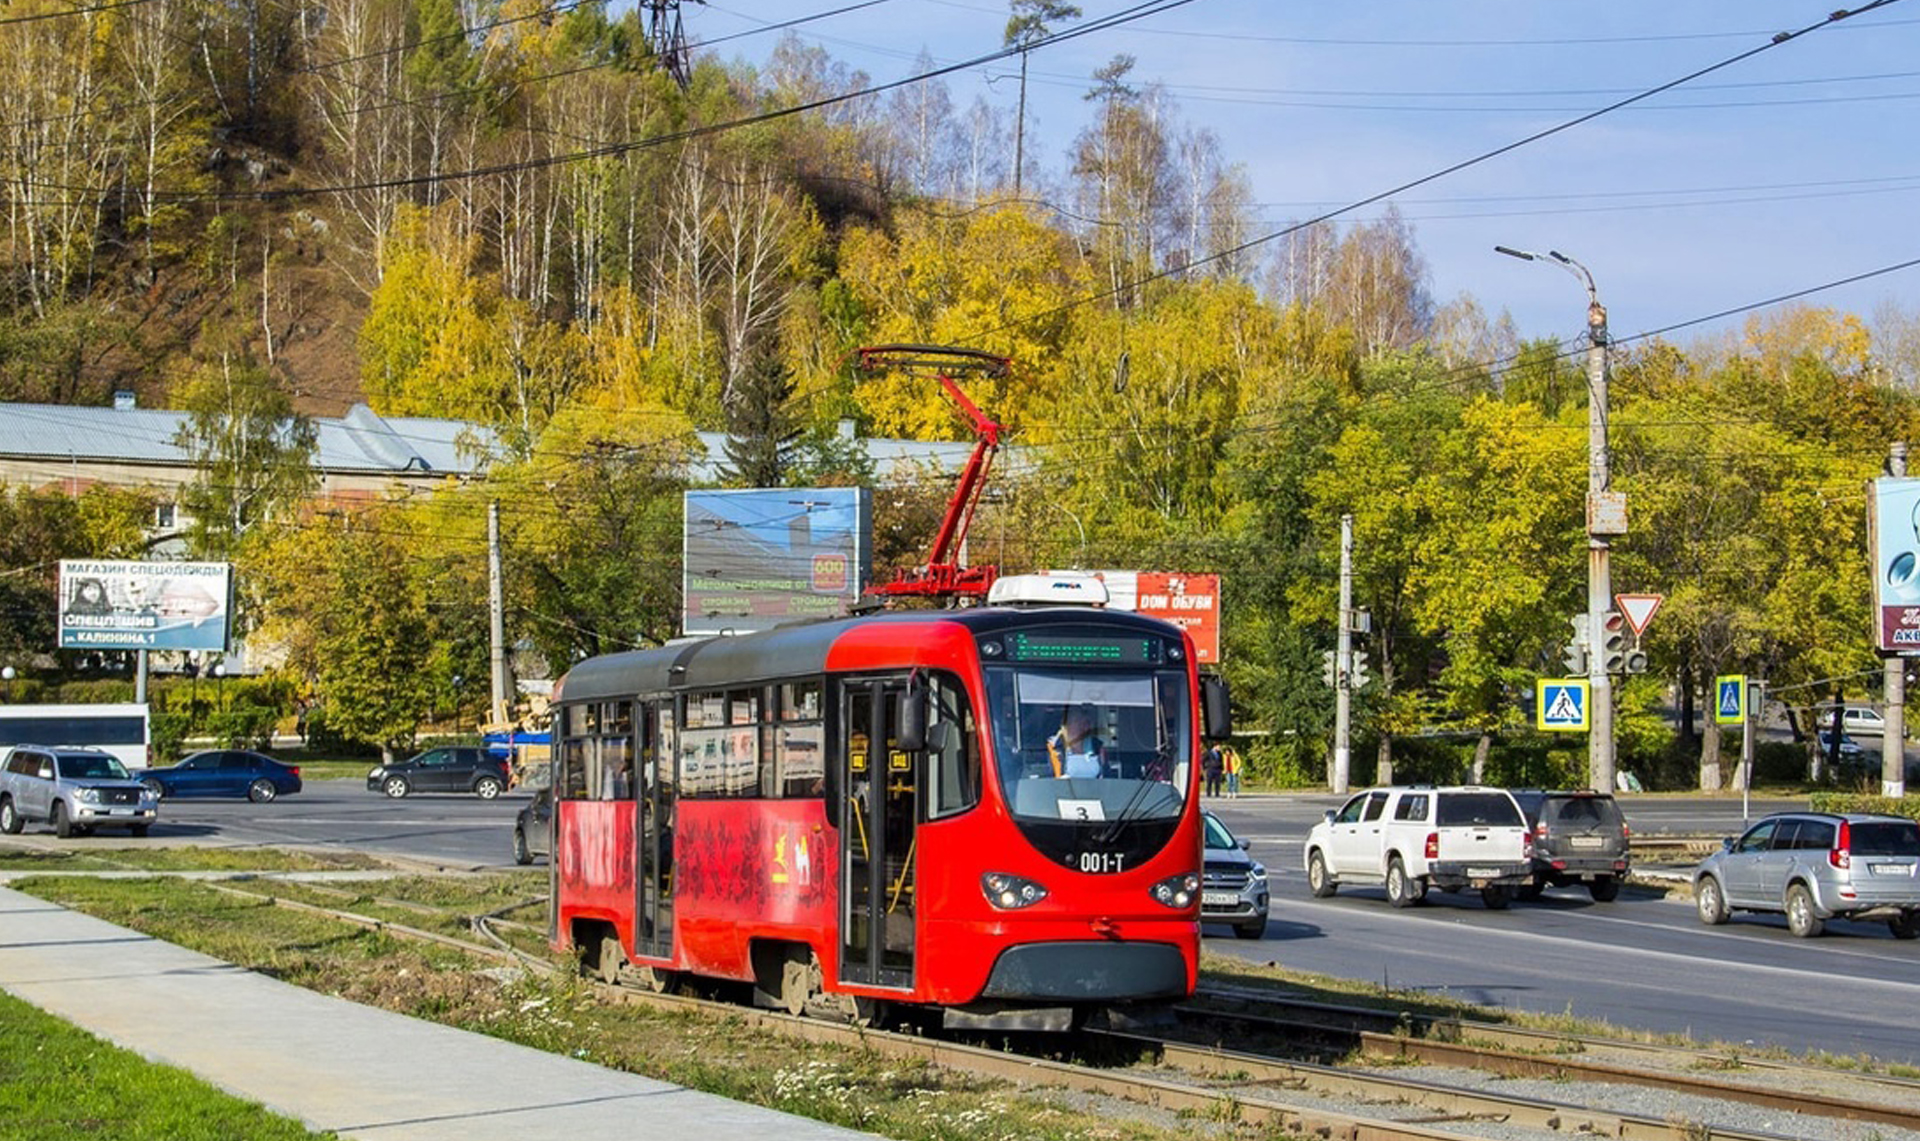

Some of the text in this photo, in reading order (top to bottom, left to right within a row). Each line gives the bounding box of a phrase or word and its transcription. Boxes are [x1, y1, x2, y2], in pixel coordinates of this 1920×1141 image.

[66, 564, 223, 576] МАГАЗИН СПЕЦОДЕЖДЫ
[815, 560, 844, 573] 600
[1172, 594, 1212, 608] ОБУВИ
[1076, 807, 1089, 821] 3
[1081, 852, 1124, 873] 001-T
